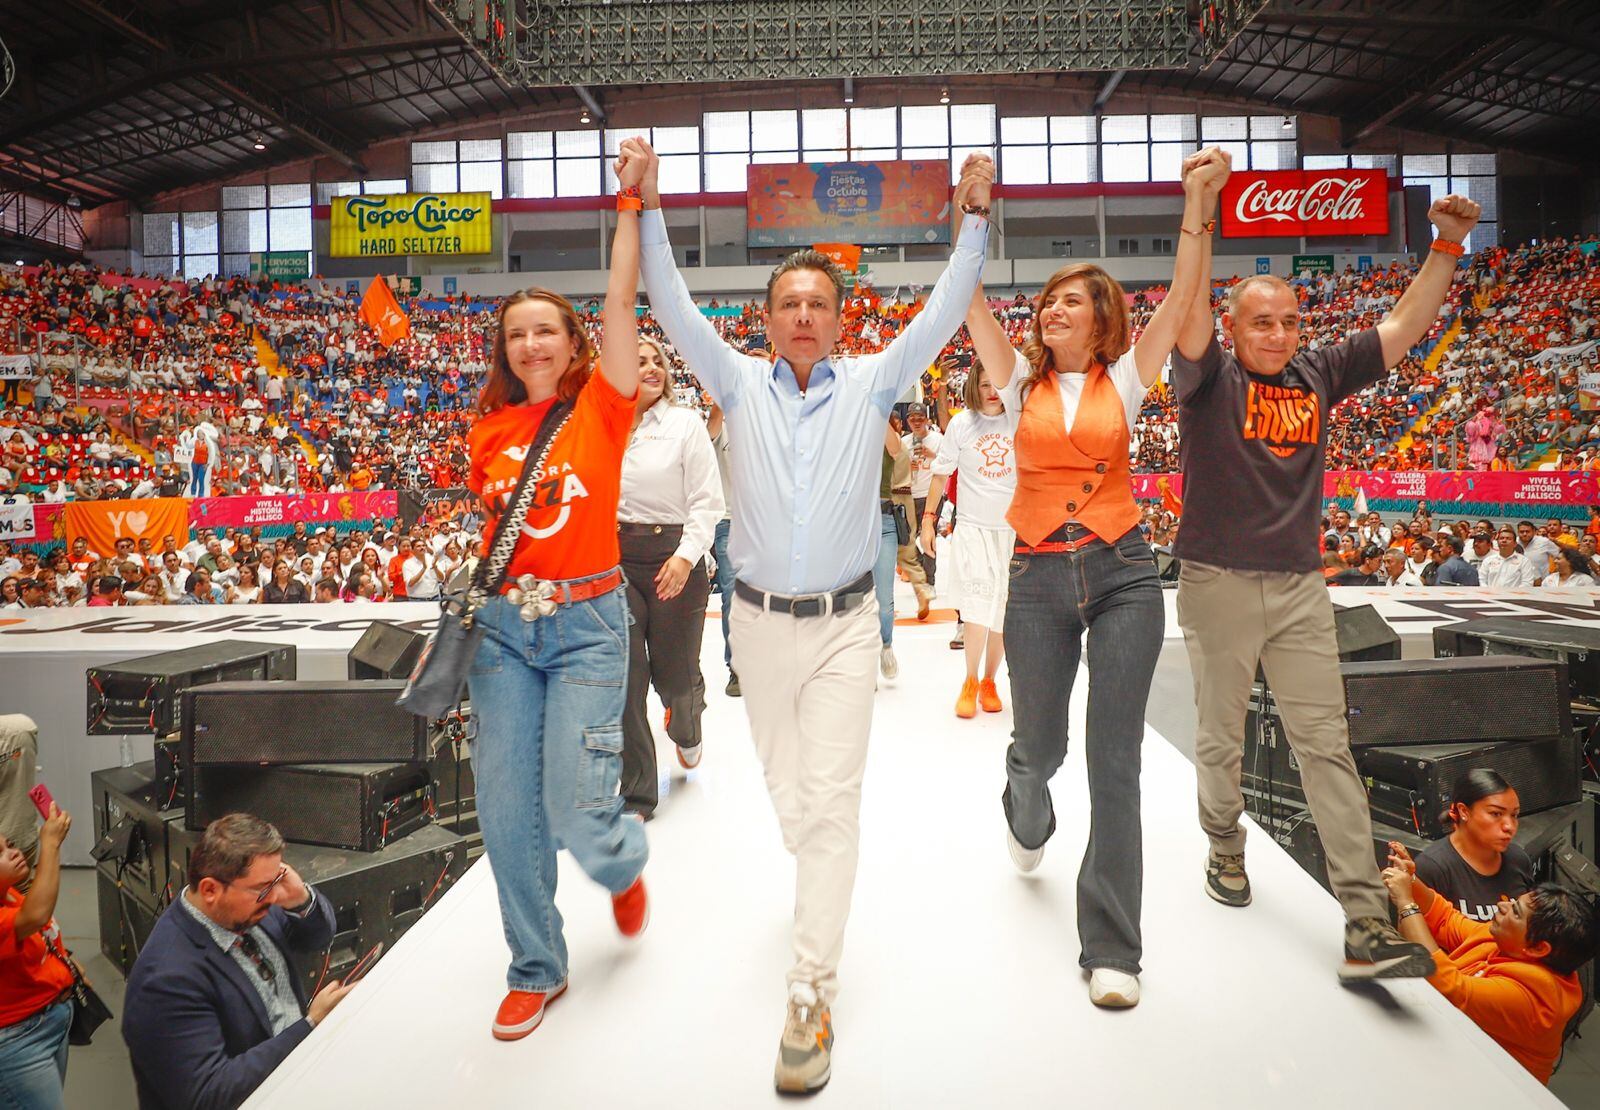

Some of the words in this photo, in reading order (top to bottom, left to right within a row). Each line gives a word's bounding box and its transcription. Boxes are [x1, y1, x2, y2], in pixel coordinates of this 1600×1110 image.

[830, 175, 866, 187] Fiestas
[826, 187, 868, 198] Octubre
[1235, 177, 1370, 223] Coca-Cola
[346, 197, 412, 233] Topo
[412, 195, 482, 233] Chico
[360, 238, 396, 255] HARD
[403, 236, 461, 254] SELTZER
[263, 257, 307, 267] SERVICIOS
[1257, 263, 1269, 273] 10
[973, 432, 1001, 452] Jalisco
[977, 466, 1013, 478] Estrella
[1529, 477, 1549, 485] VIVE
[1549, 477, 1562, 485] LA
[1521, 484, 1562, 492] HISTORIA
[1527, 492, 1562, 500] JALISCO
[250, 507, 283, 515] HISTORIA
[244, 515, 254, 523] DE
[255, 514, 283, 522] JALISCO
